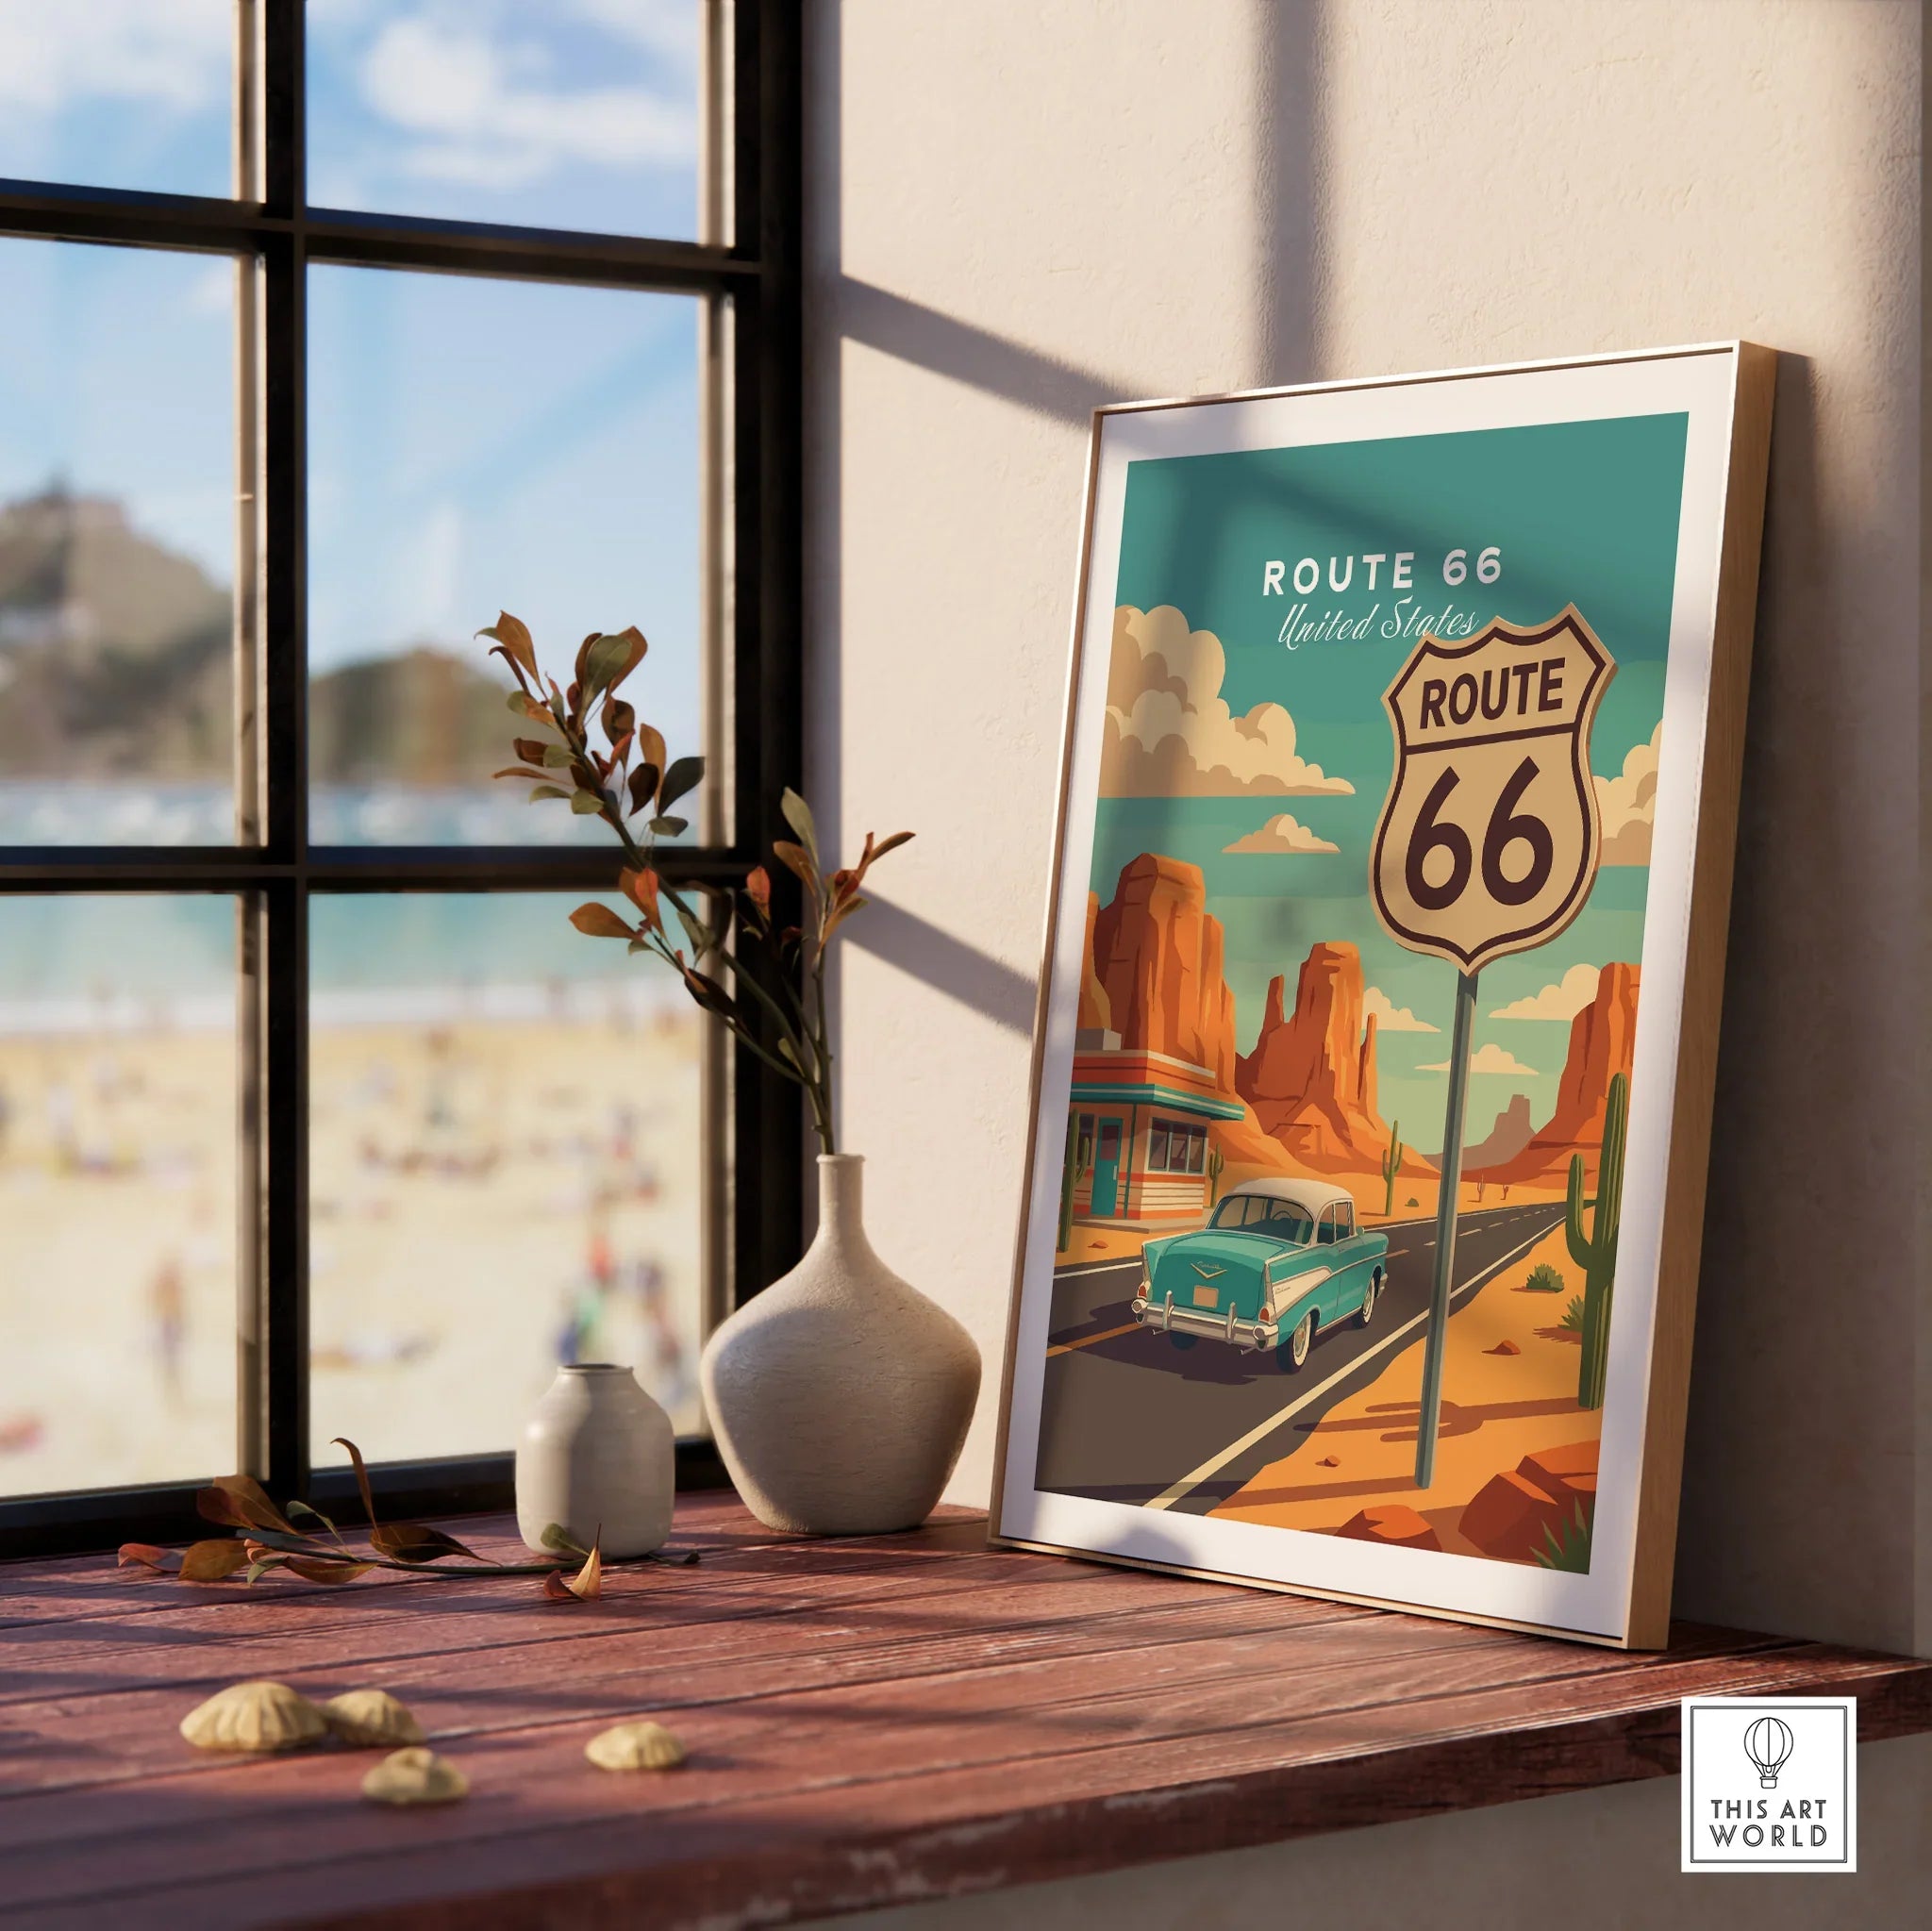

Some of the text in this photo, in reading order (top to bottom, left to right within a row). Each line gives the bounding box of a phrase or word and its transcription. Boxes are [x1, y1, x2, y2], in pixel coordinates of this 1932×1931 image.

[1262, 546, 1503, 596] ROUTE 66
[1277, 596, 1479, 650] United States
[1419, 657, 1566, 729] ROUTE
[1405, 755, 1554, 910] 66
